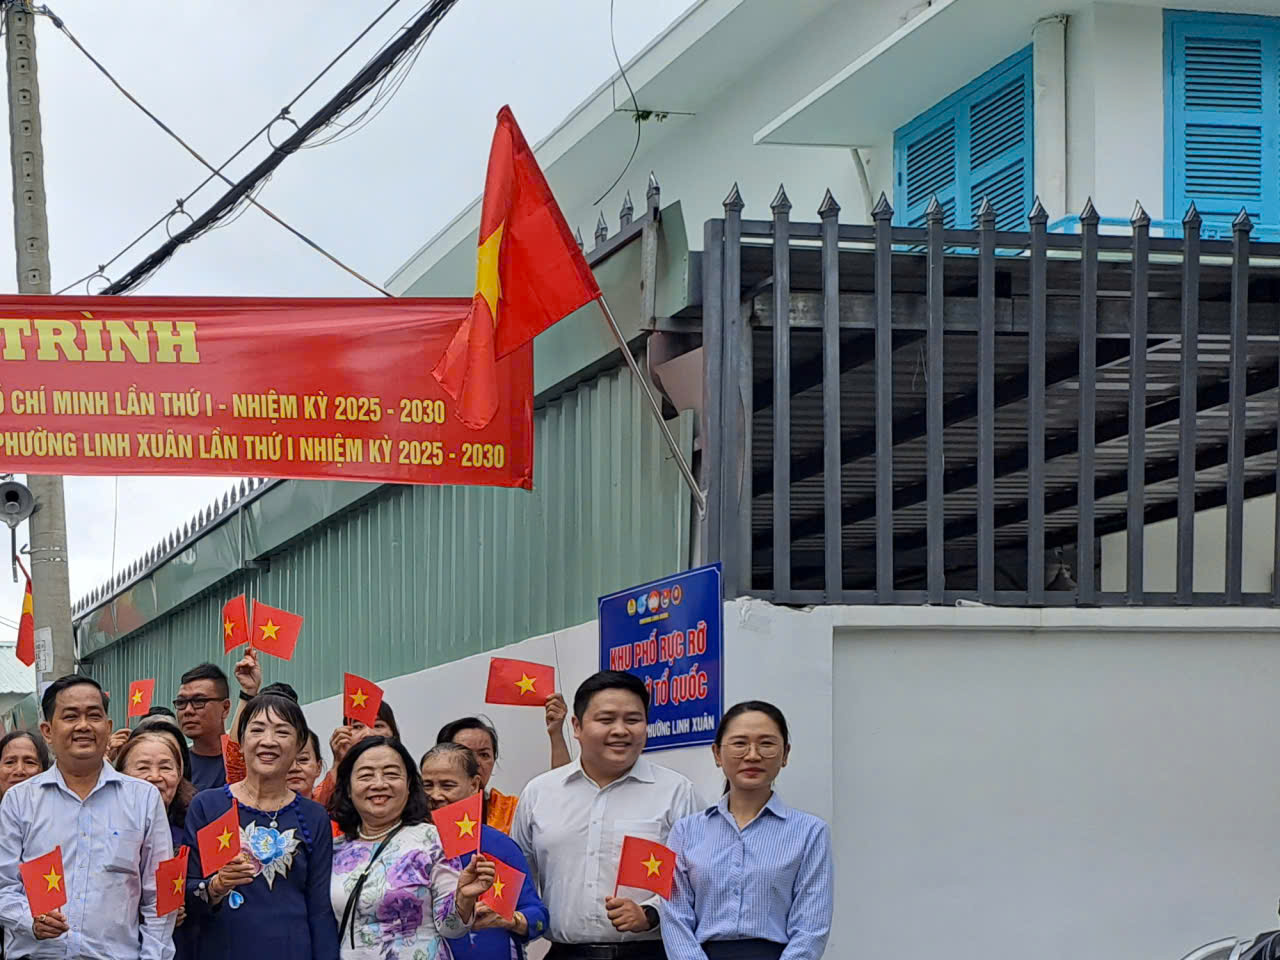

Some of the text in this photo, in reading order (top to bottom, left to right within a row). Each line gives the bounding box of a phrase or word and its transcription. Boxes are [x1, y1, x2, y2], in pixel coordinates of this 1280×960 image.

[11, 386, 47, 415] CHÍ
[53, 390, 108, 416] MINH
[115, 384, 155, 417] LẦN
[160, 387, 201, 418] THỨ
[205, 394, 213, 417] I
[232, 390, 297, 424] NHIỆM
[303, 391, 330, 421] KỲ
[334, 396, 382, 422] 2025
[399, 399, 445, 424] 2030
[83, 432, 131, 457] LINH
[136, 428, 193, 459] XUÂN
[199, 427, 238, 460] LẦN
[244, 434, 283, 461] THỨ
[287, 436, 295, 461] I
[300, 433, 363, 468] NHIỆM
[369, 434, 392, 464] KỲ
[398, 440, 444, 466] 2025
[461, 443, 505, 468] 2030
[610, 644, 632, 671] KHU
[634, 628, 657, 668] PHỐ
[659, 630, 685, 666] RỰC
[671, 663, 708, 706] QUỐC
[647, 712, 715, 738] HƯỜNG LINH XUÂN
